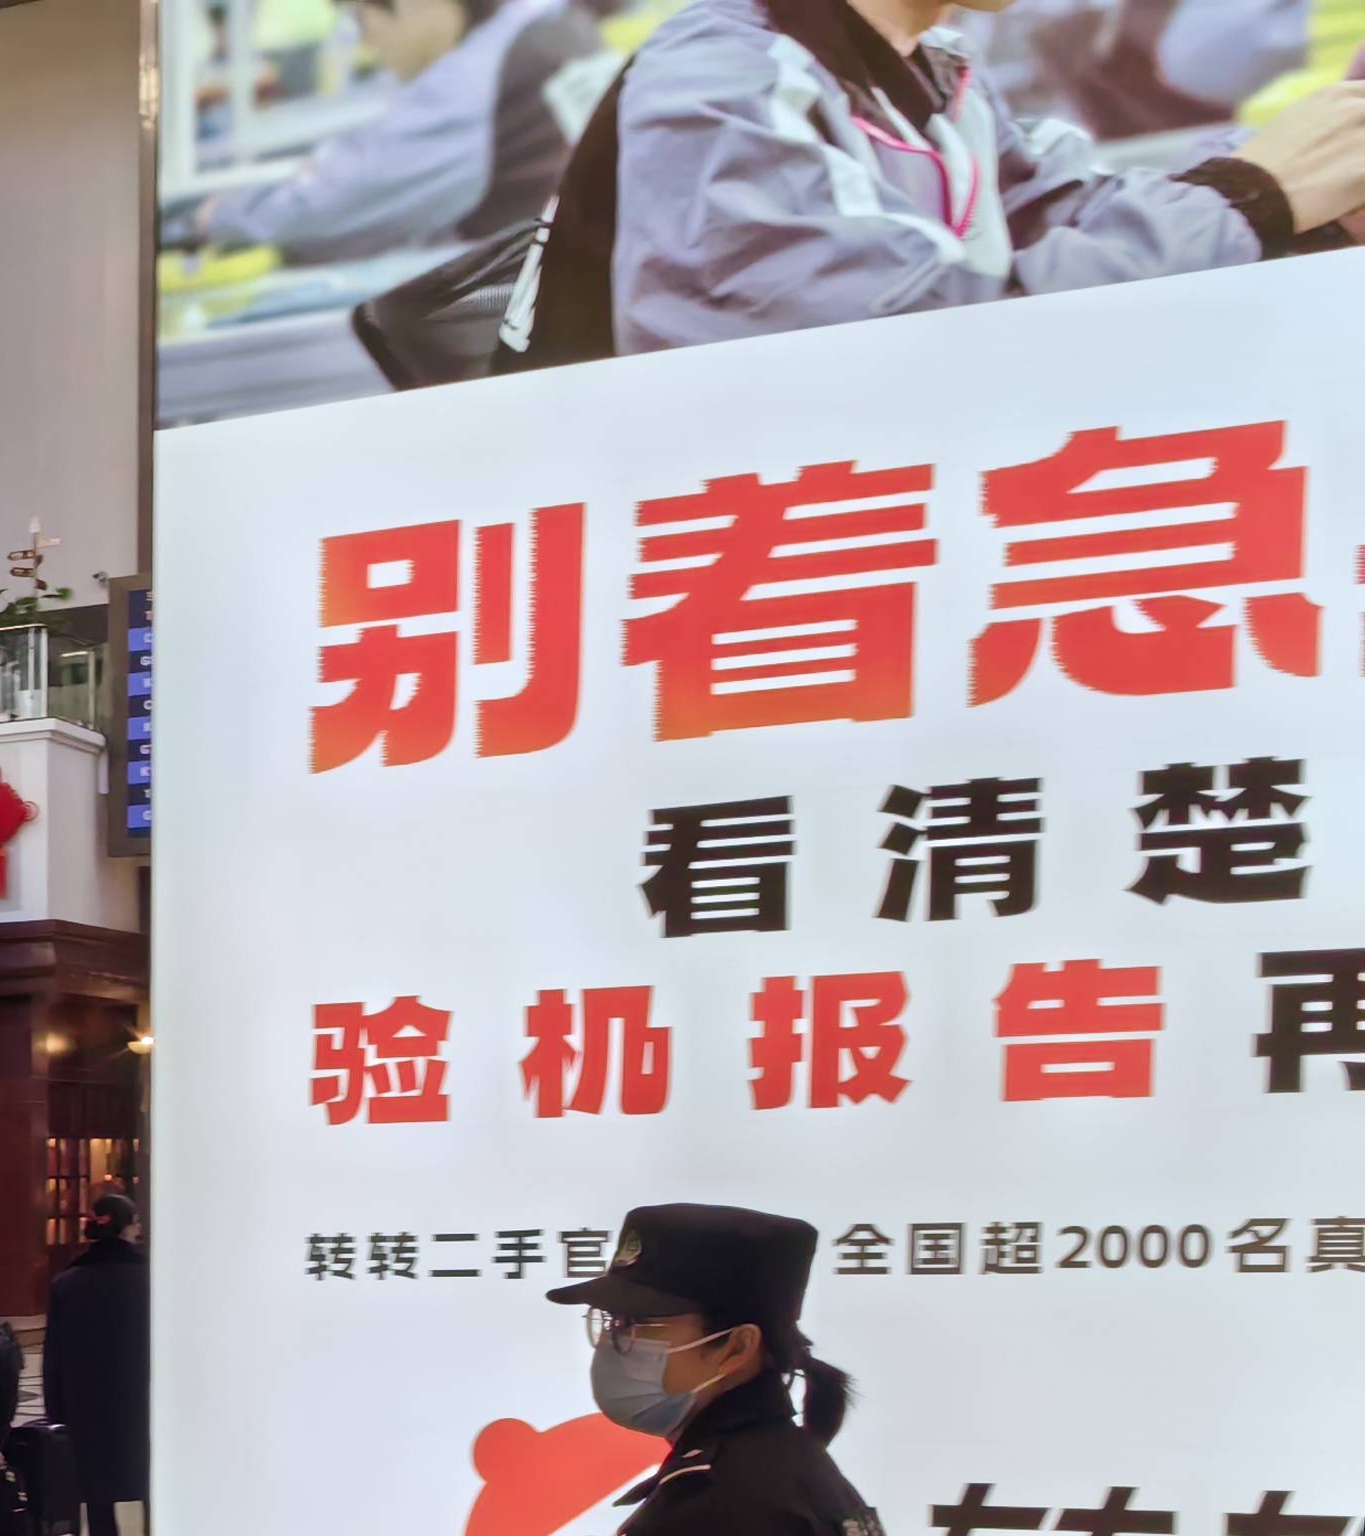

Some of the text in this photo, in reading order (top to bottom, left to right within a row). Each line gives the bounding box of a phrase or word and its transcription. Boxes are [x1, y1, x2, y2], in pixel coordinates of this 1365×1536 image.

[307, 419, 1365, 775] 别着急
[639, 756, 1311, 939] 看清楚
[308, 947, 1365, 1127] 验机报告再
